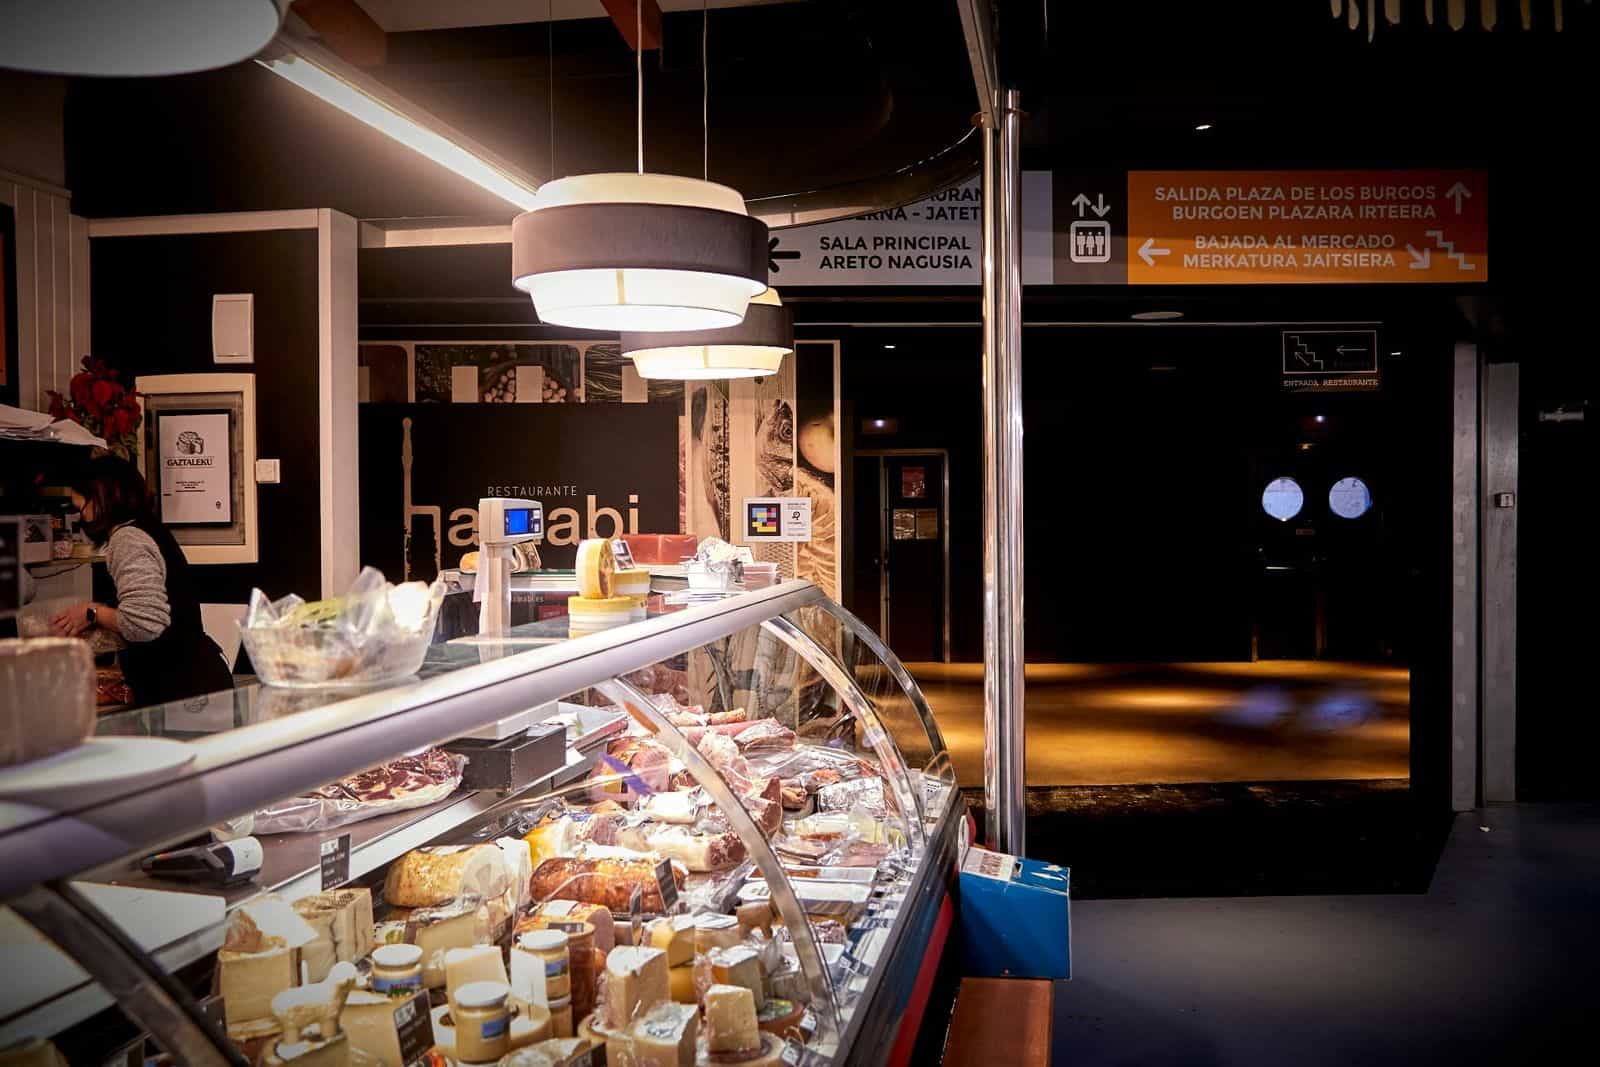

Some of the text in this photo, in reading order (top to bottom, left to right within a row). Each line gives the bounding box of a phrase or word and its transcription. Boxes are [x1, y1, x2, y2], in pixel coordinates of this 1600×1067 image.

[1154, 185, 1436, 201] SALIDA PLAZA DE LOS BURGOS
[926, 206, 981, 220] JATET
[1172, 204, 1437, 220] BURGOEN PLAZARA IRTEERA
[819, 236, 971, 250] SALA PRINCIPAL
[1195, 234, 1395, 249] BAJADA AL MERCADO
[819, 255, 972, 269] ARETO NAGUSIA
[1183, 253, 1396, 268] MERKATURA JAITSIERA
[167, 458, 213, 467] GAZTALEKU
[487, 485, 578, 497] RESTAURANTE
